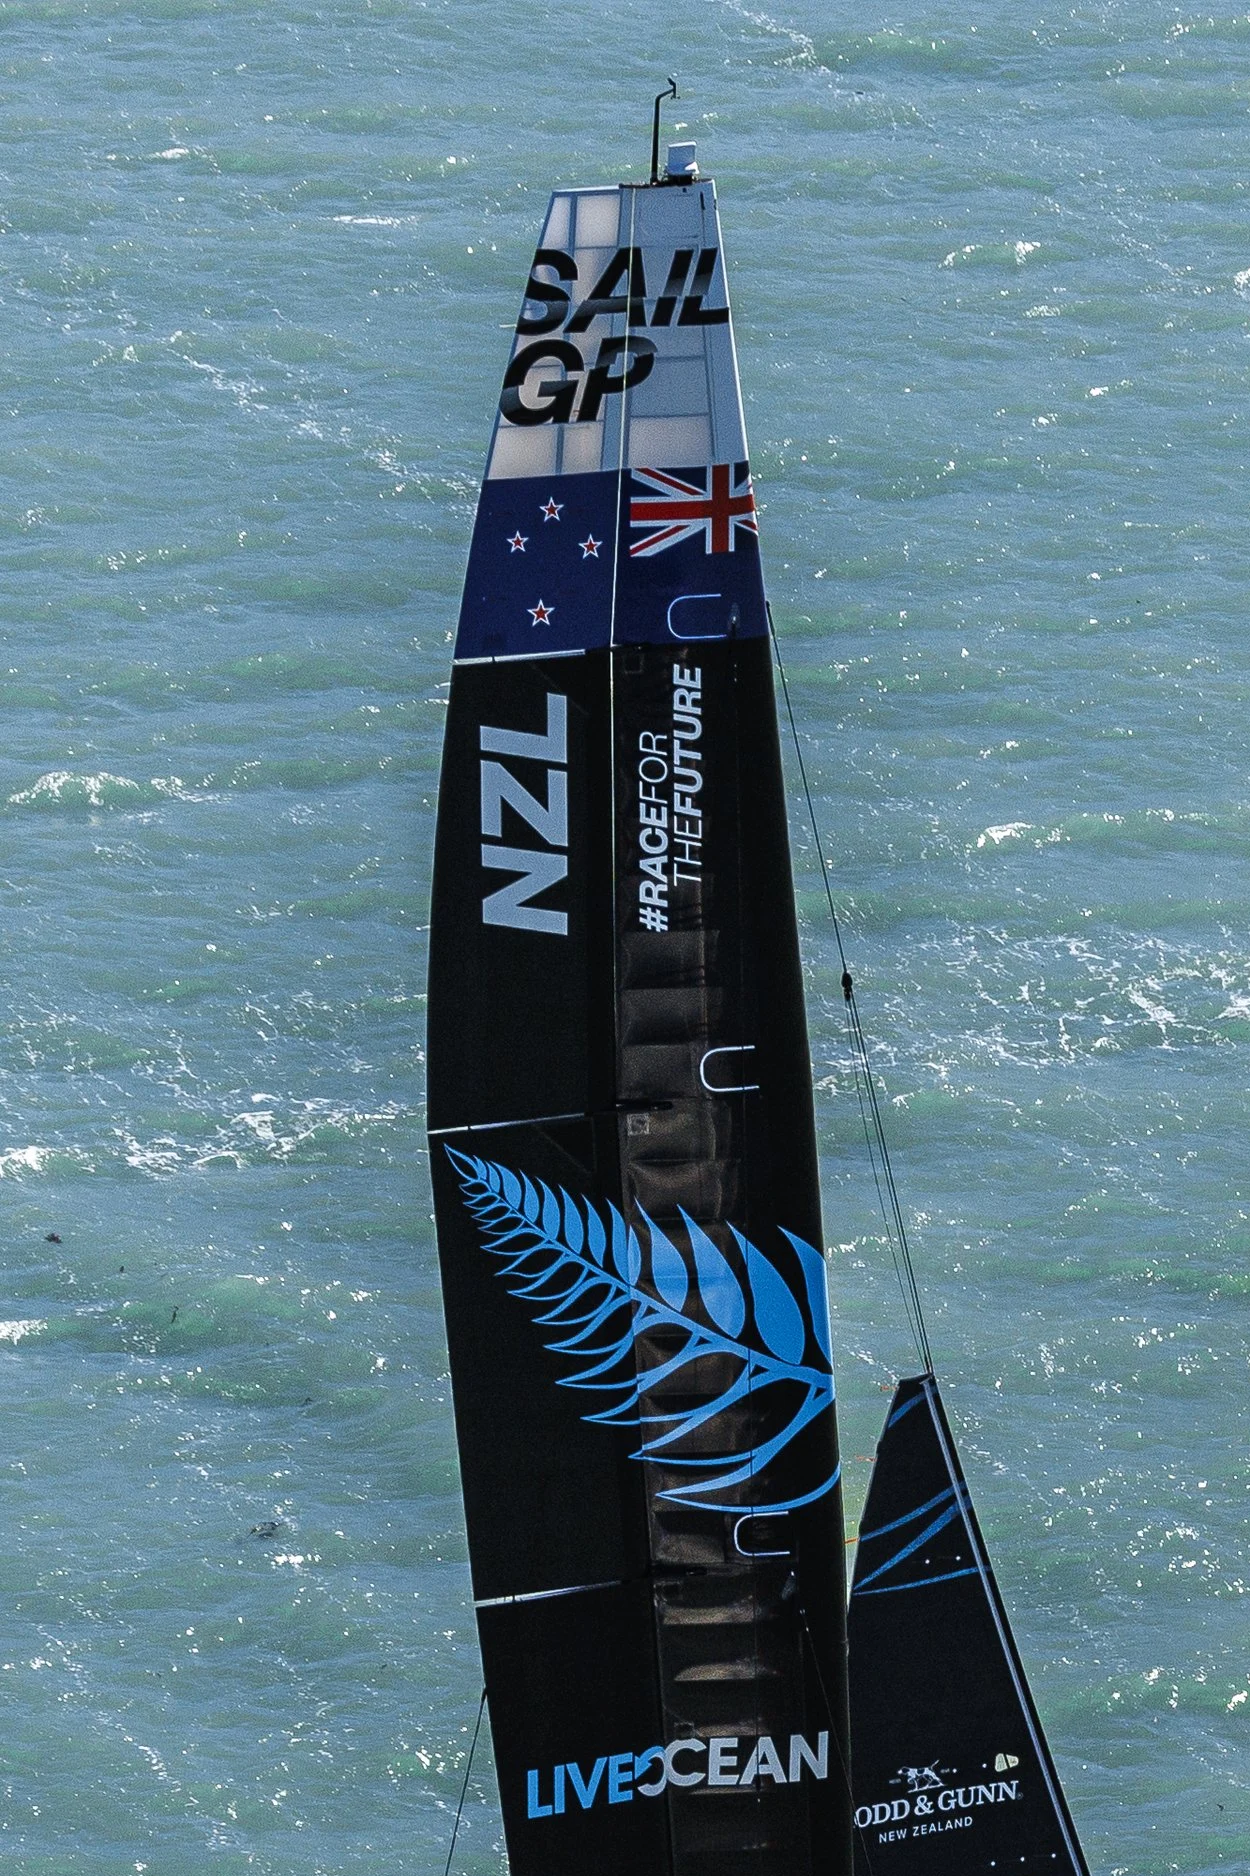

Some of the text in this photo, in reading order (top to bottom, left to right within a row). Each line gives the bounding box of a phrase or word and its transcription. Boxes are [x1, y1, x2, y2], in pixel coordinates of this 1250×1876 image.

[515, 246, 730, 335] SAIL
[499, 335, 658, 426] GP
[480, 692, 568, 936] NZL
[673, 663, 703, 888] THEFUTURE
[638, 731, 669, 933] #RACEFOR
[853, 1799, 910, 1829] ODD
[878, 1816, 974, 1844] NEW ZEALAND
